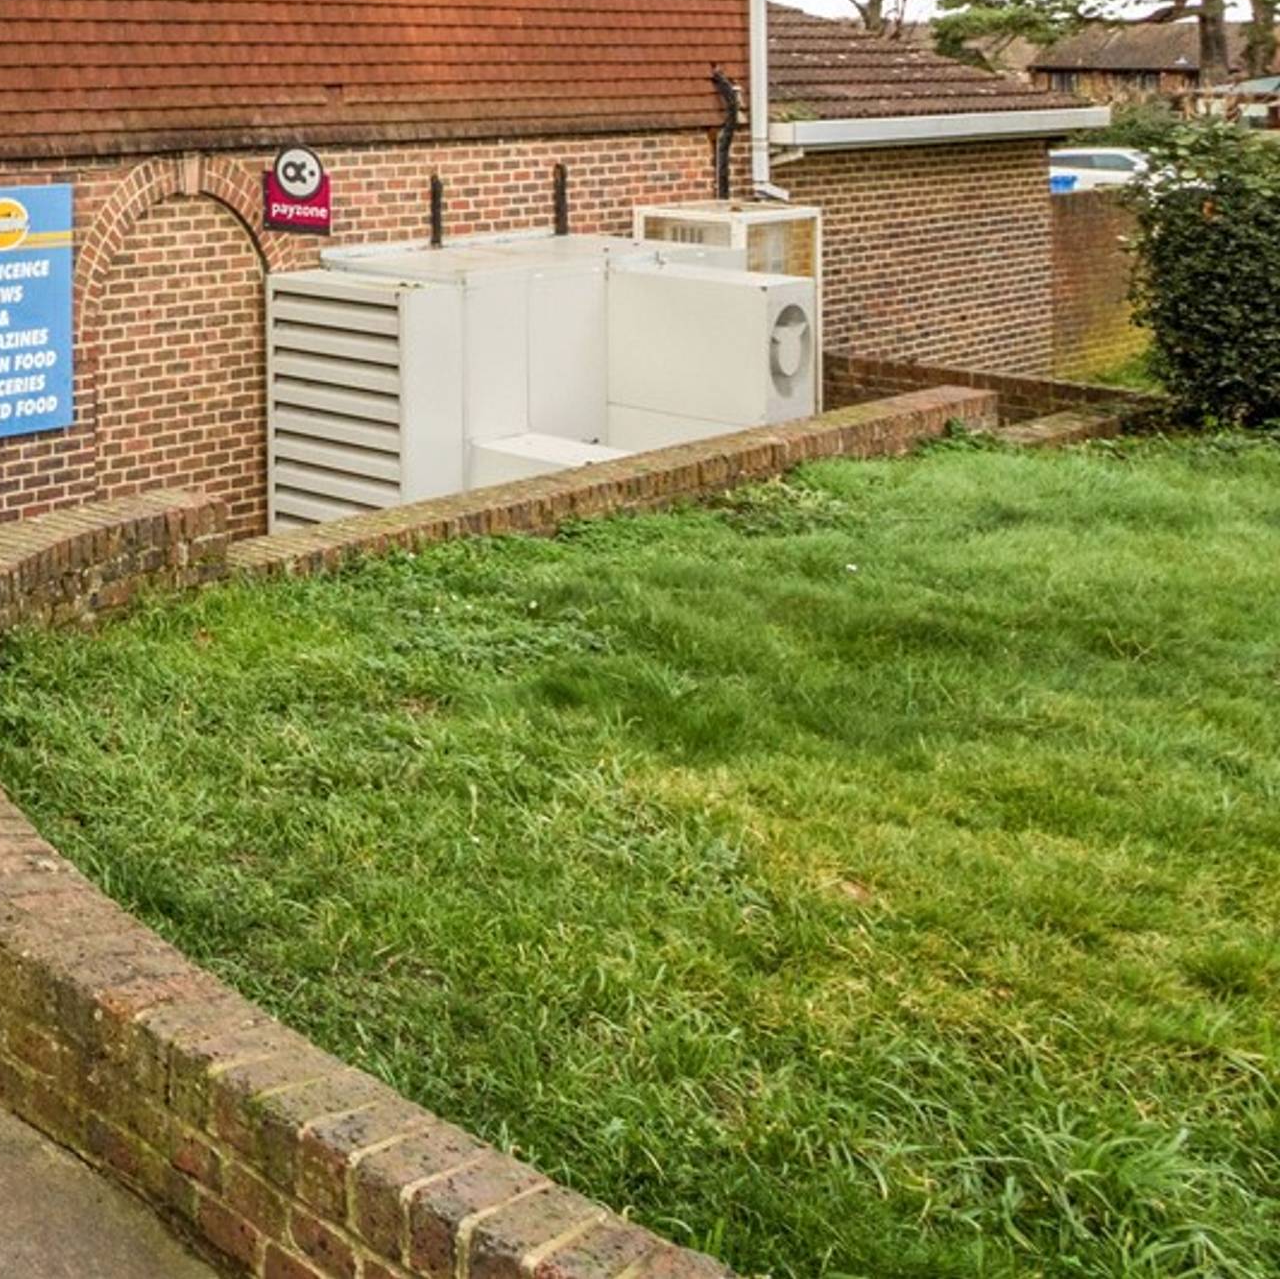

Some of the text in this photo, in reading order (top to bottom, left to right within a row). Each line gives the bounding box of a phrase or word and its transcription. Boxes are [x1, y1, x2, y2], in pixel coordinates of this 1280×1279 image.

[271, 203, 328, 219] payzone
[14, 350, 57, 371] FOOD
[15, 395, 58, 418] FOOD
